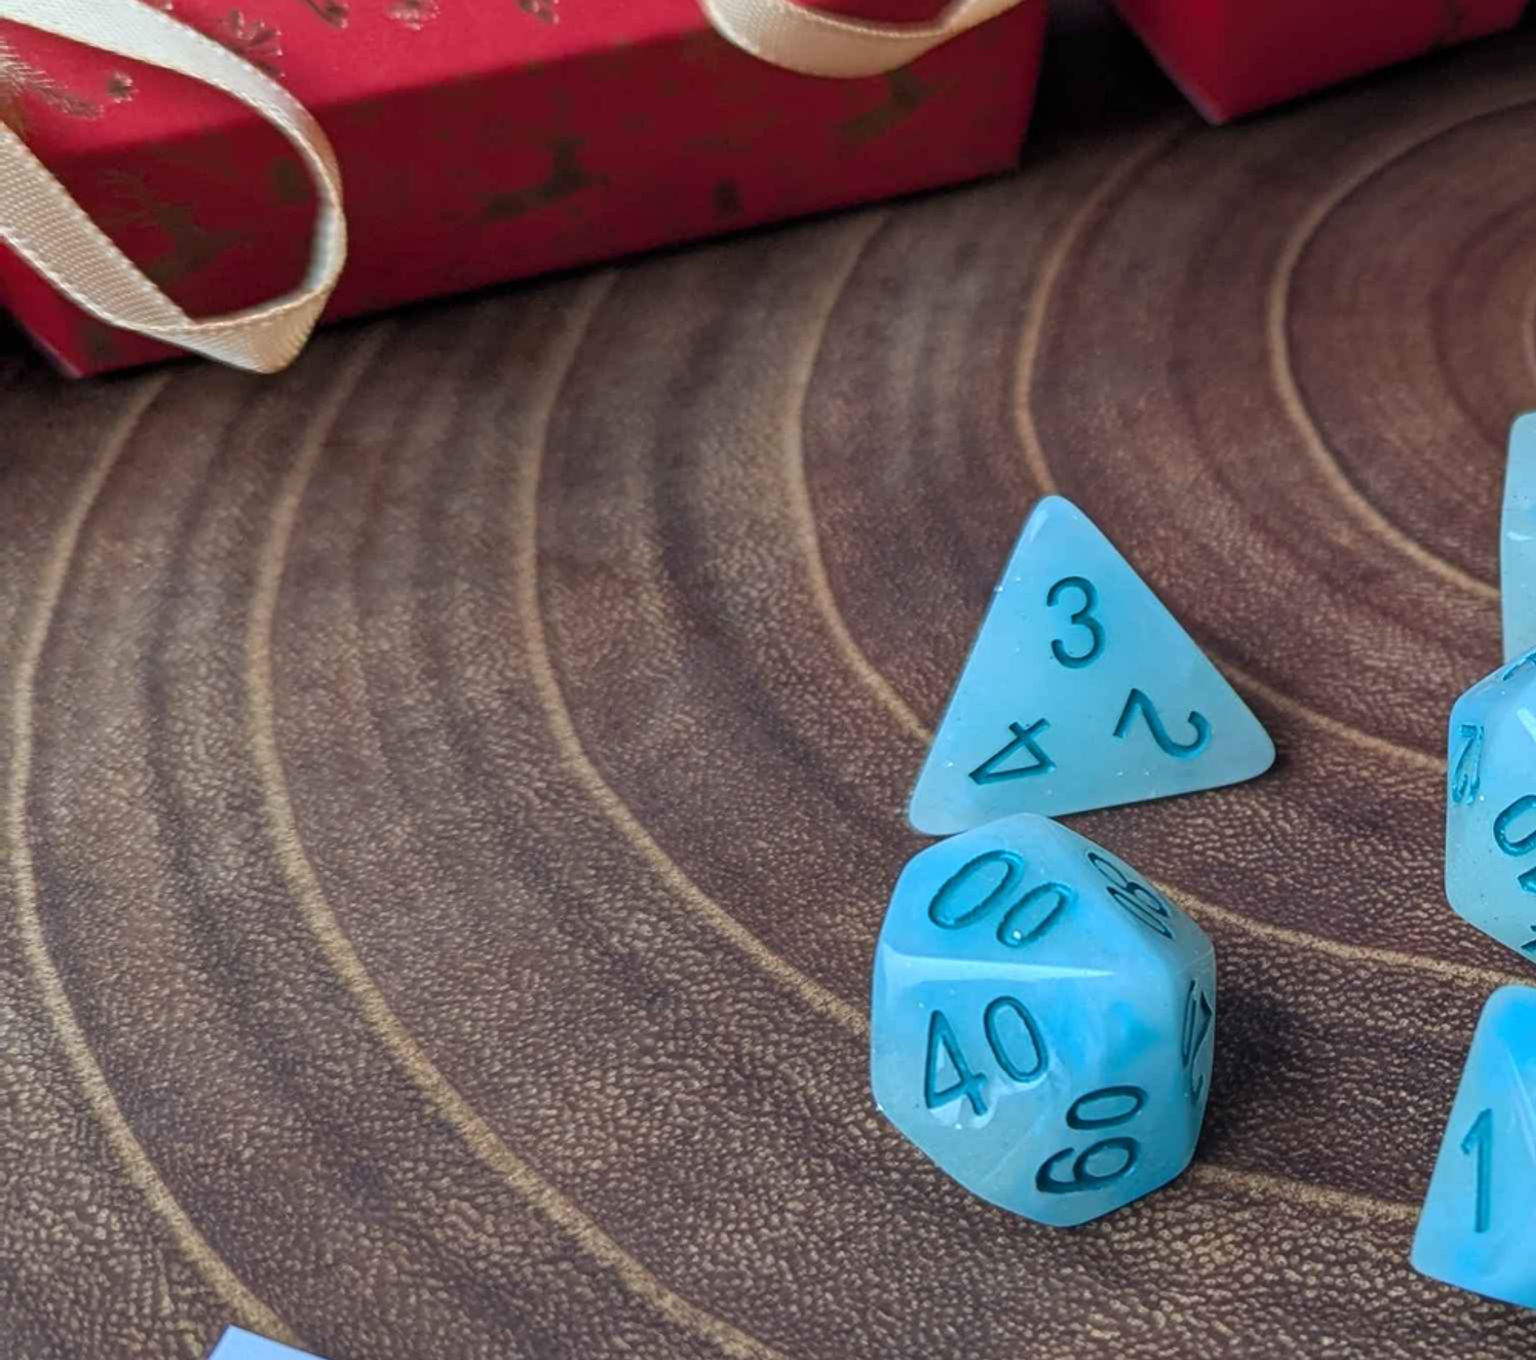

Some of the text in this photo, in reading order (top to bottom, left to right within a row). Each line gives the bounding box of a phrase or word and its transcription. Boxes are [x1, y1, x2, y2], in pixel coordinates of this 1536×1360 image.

[1047, 576, 1106, 669] 3
[968, 717, 1055, 785] 4
[1113, 688, 1212, 759] 2
[928, 849, 1076, 948] 00
[924, 995, 1048, 1116] 40
[1460, 1108, 1492, 1233] 1
